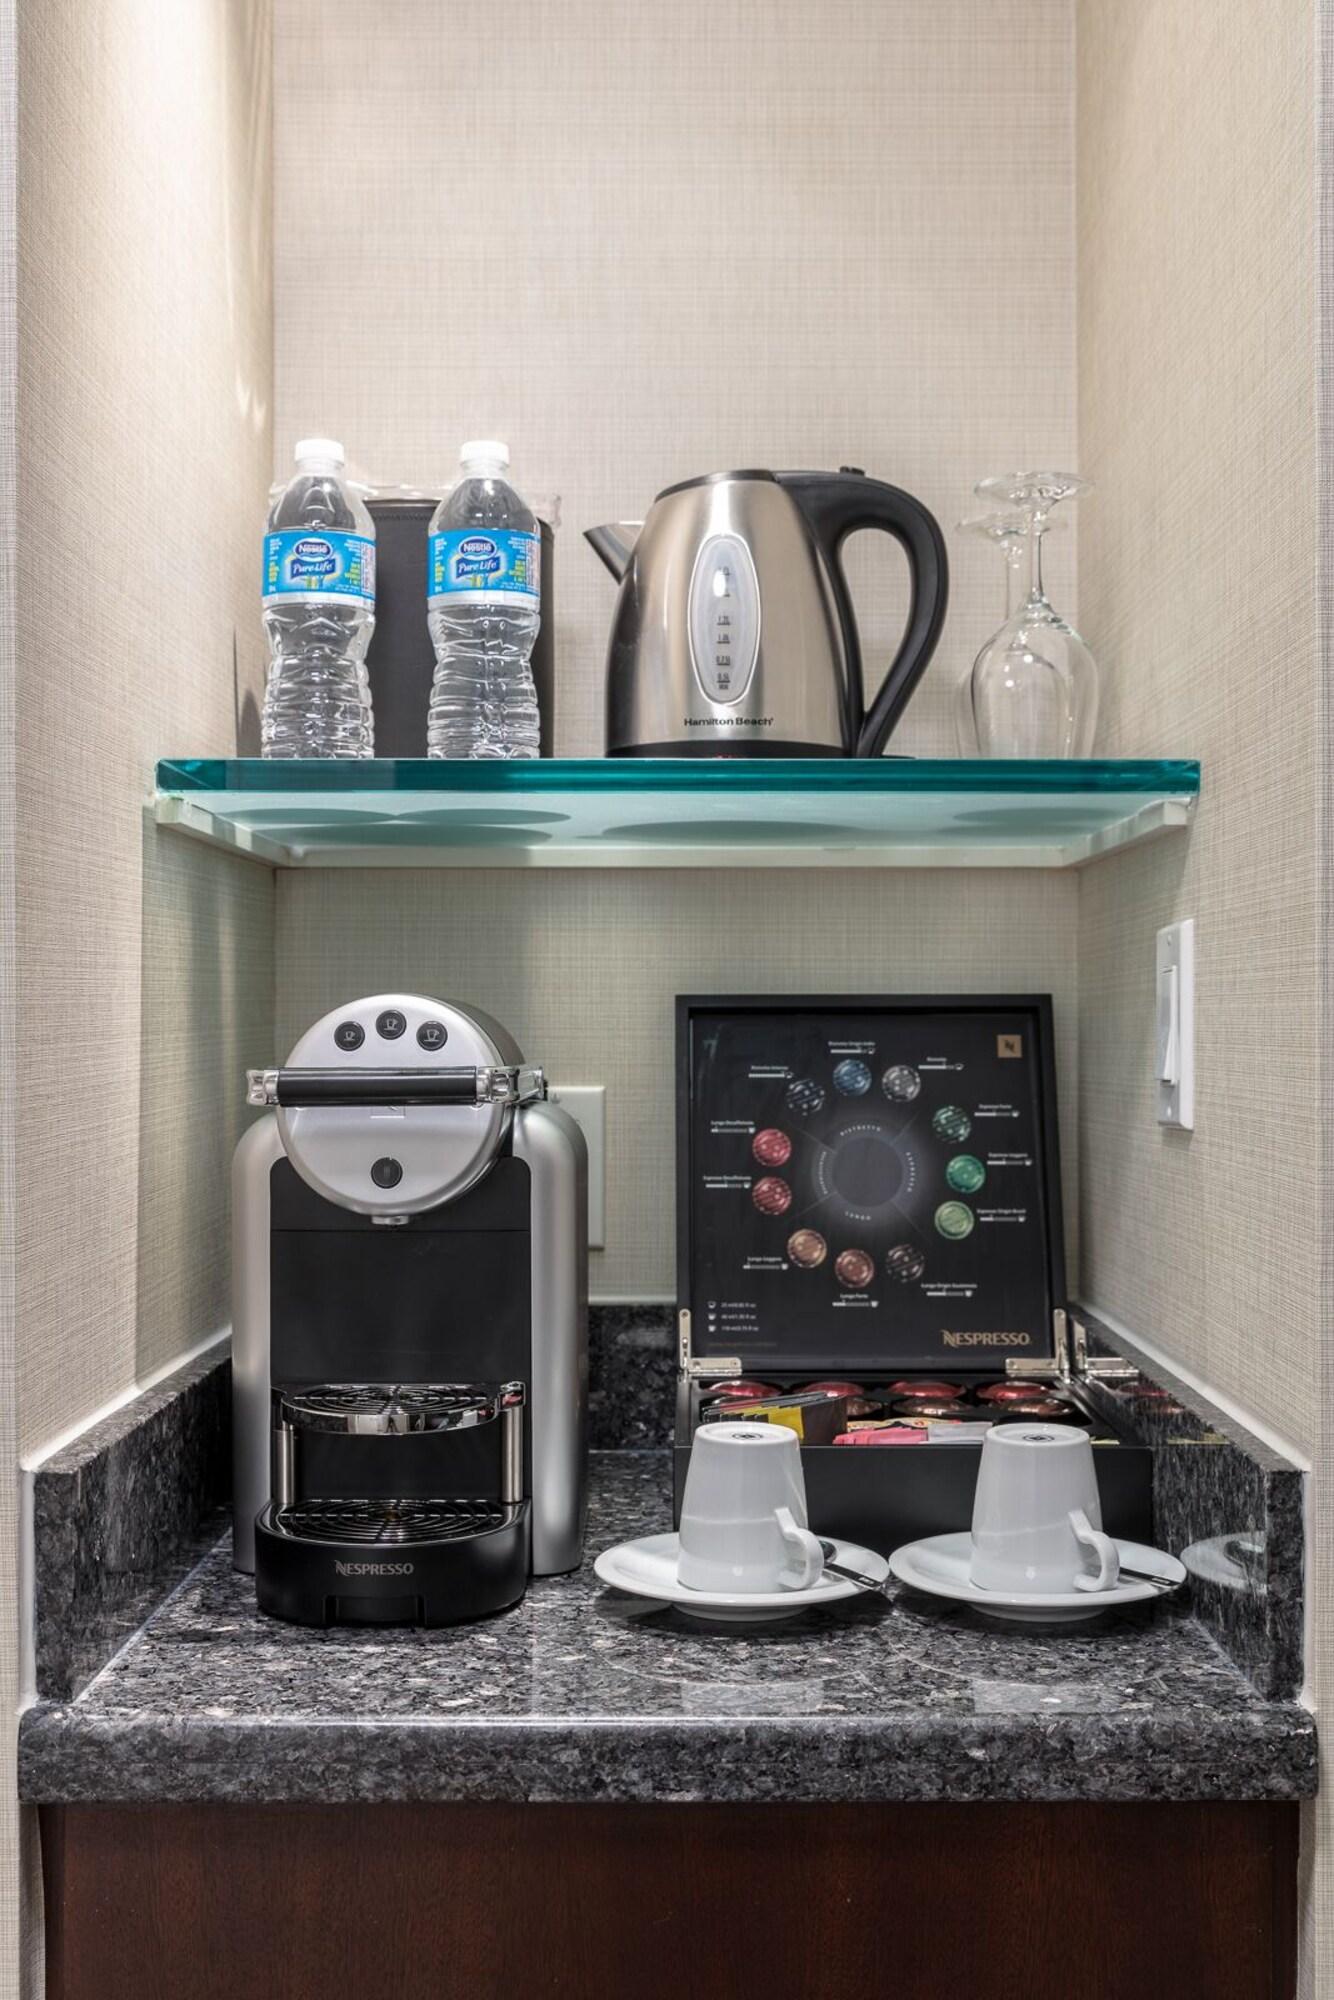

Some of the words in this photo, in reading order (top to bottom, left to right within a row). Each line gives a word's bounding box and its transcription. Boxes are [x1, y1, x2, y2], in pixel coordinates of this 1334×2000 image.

[684, 717, 734, 727] Hamilton
[941, 1328, 1031, 1348] NESPRESSO
[334, 1559, 414, 1577] NESPRESSO
